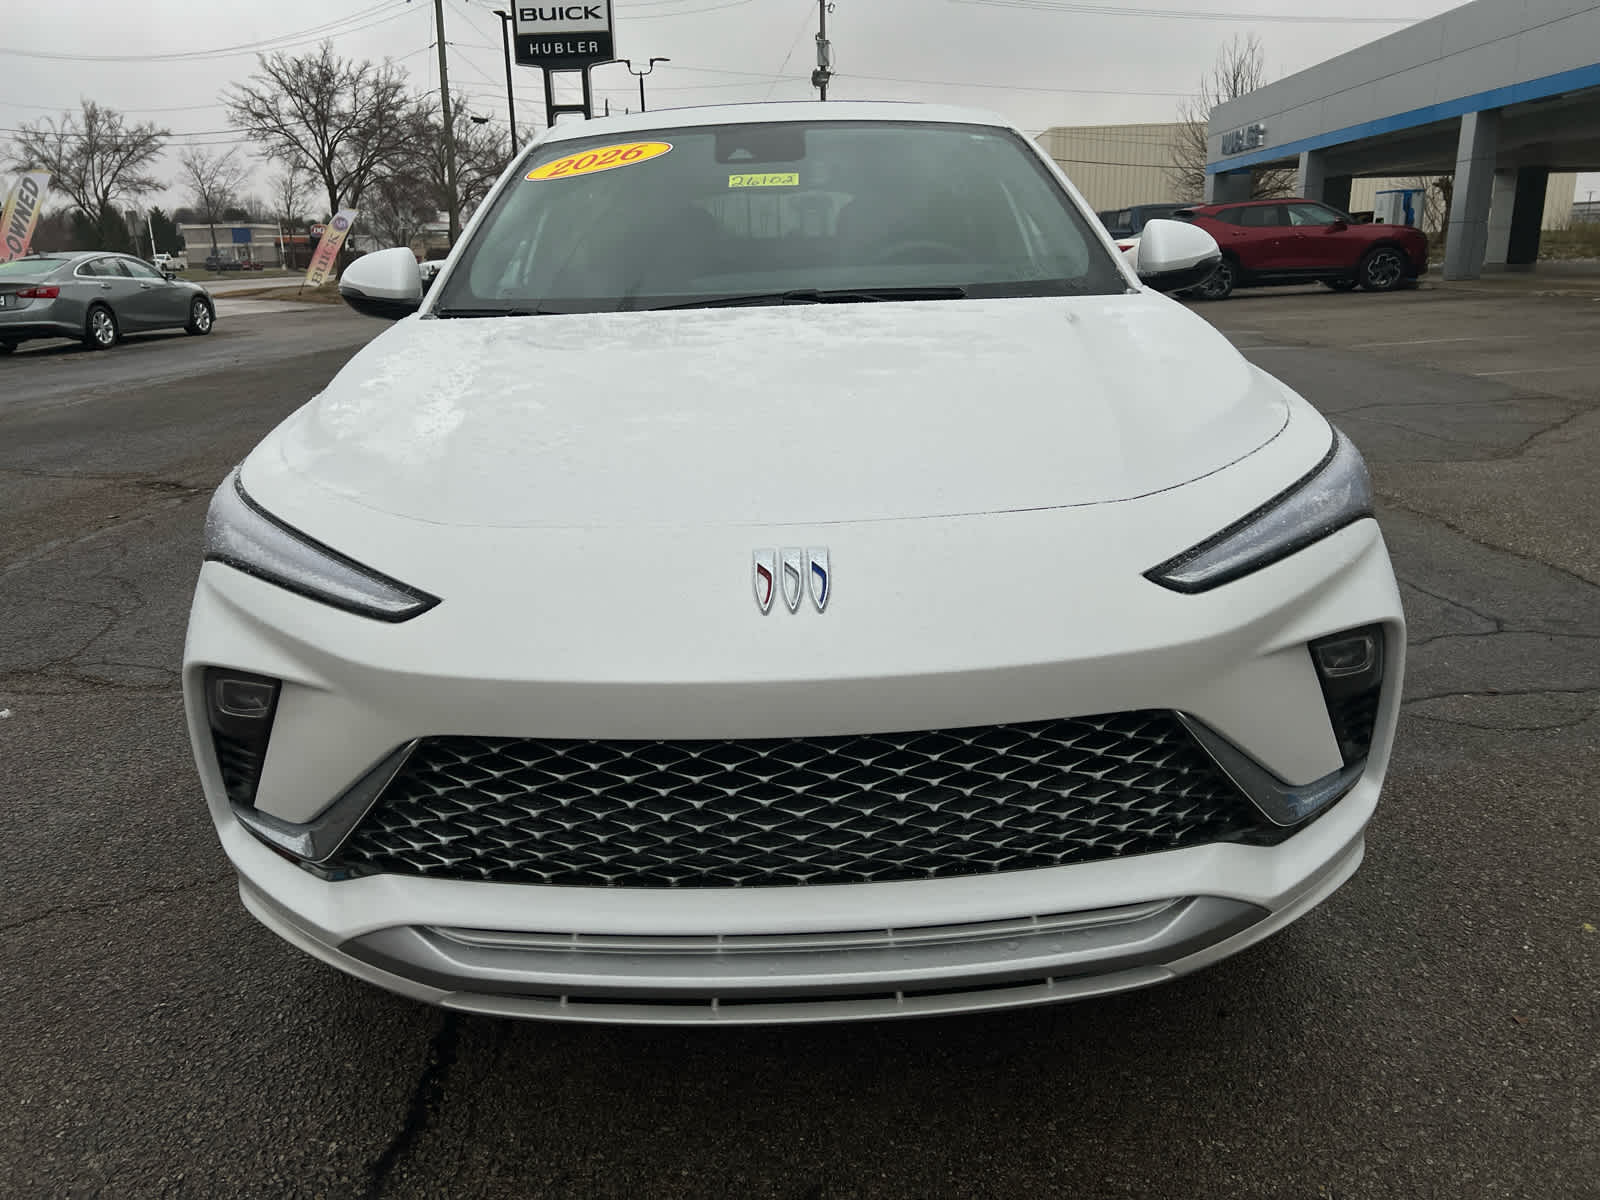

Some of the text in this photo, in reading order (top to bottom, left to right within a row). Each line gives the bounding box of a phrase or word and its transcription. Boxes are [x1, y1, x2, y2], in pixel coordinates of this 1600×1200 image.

[520, 5, 603, 21] BUICK
[529, 41, 598, 55] HUBLER
[548, 144, 649, 176] 2026
